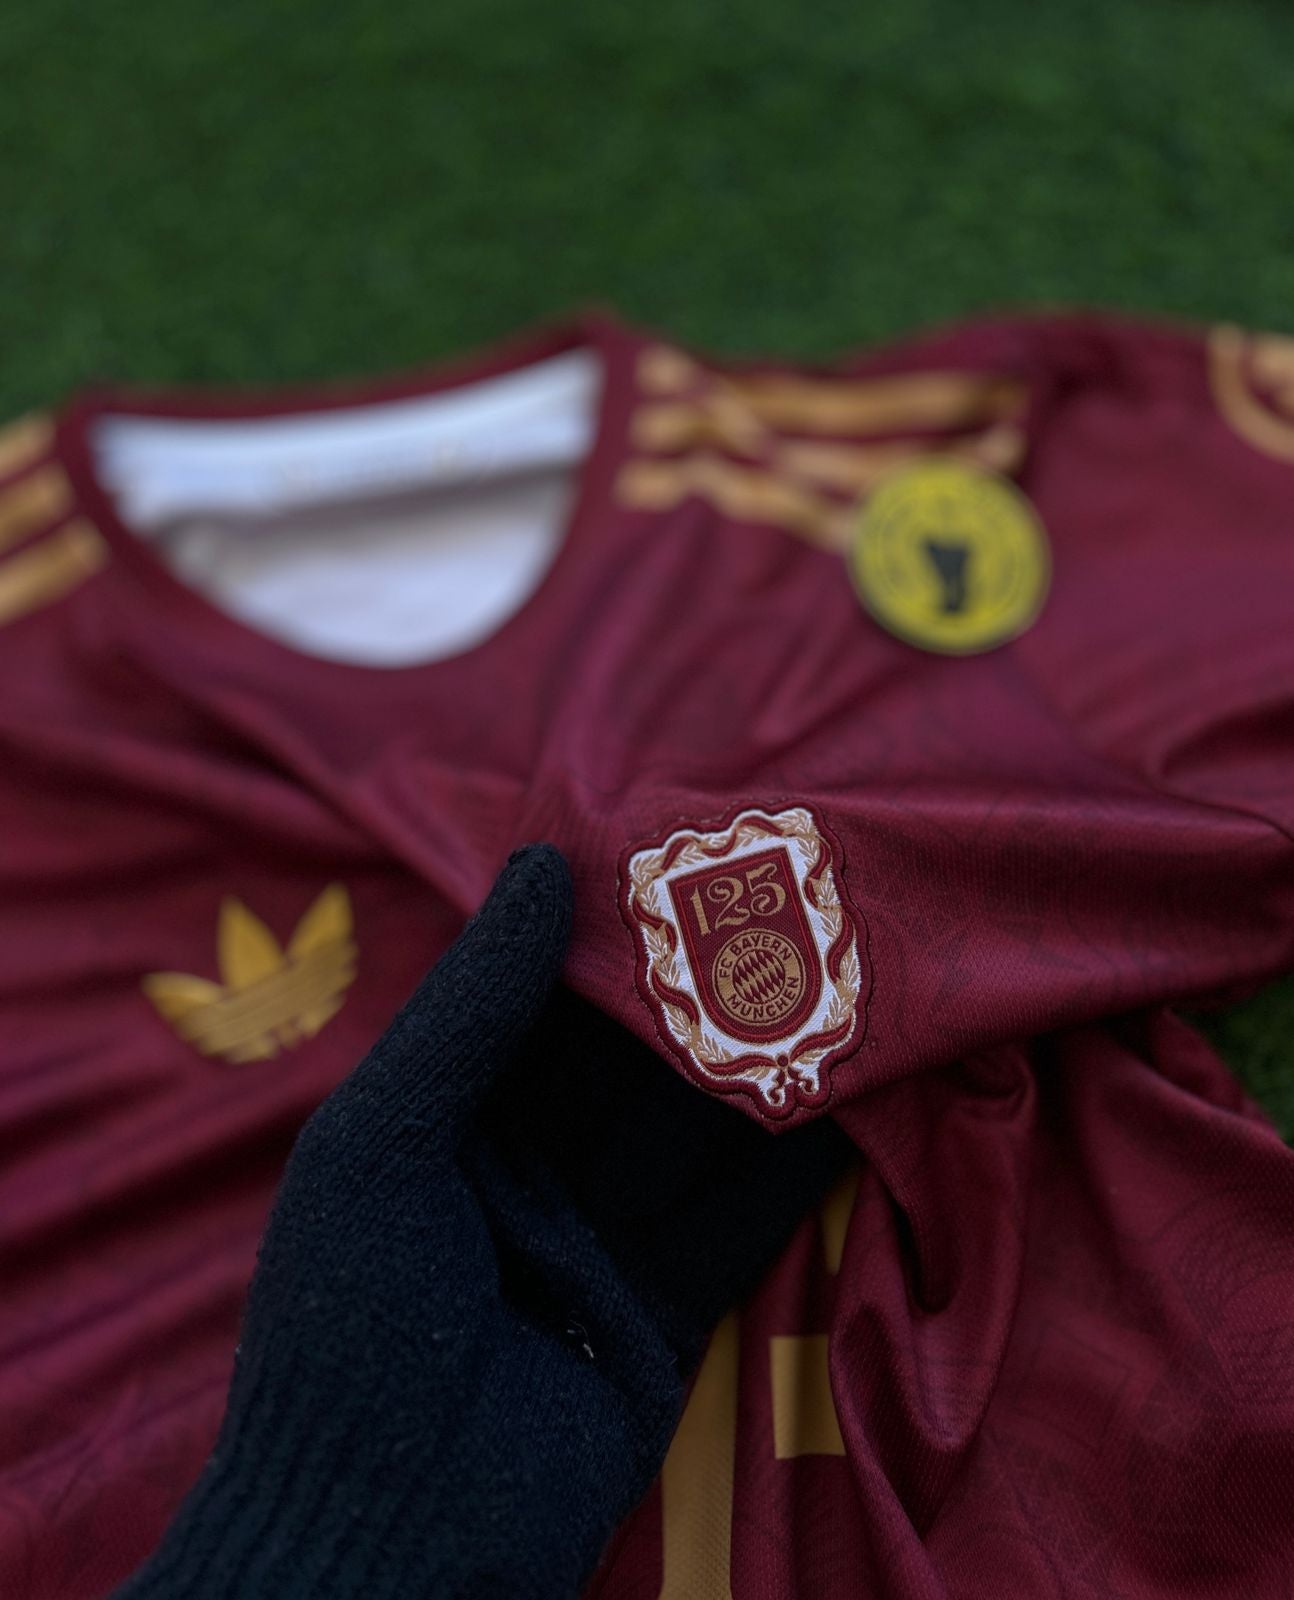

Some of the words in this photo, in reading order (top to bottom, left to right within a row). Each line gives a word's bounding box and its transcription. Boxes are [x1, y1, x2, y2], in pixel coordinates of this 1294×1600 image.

[690, 863, 786, 936] 125
[719, 957, 733, 978] FC
[729, 934, 792, 961] BAYERN
